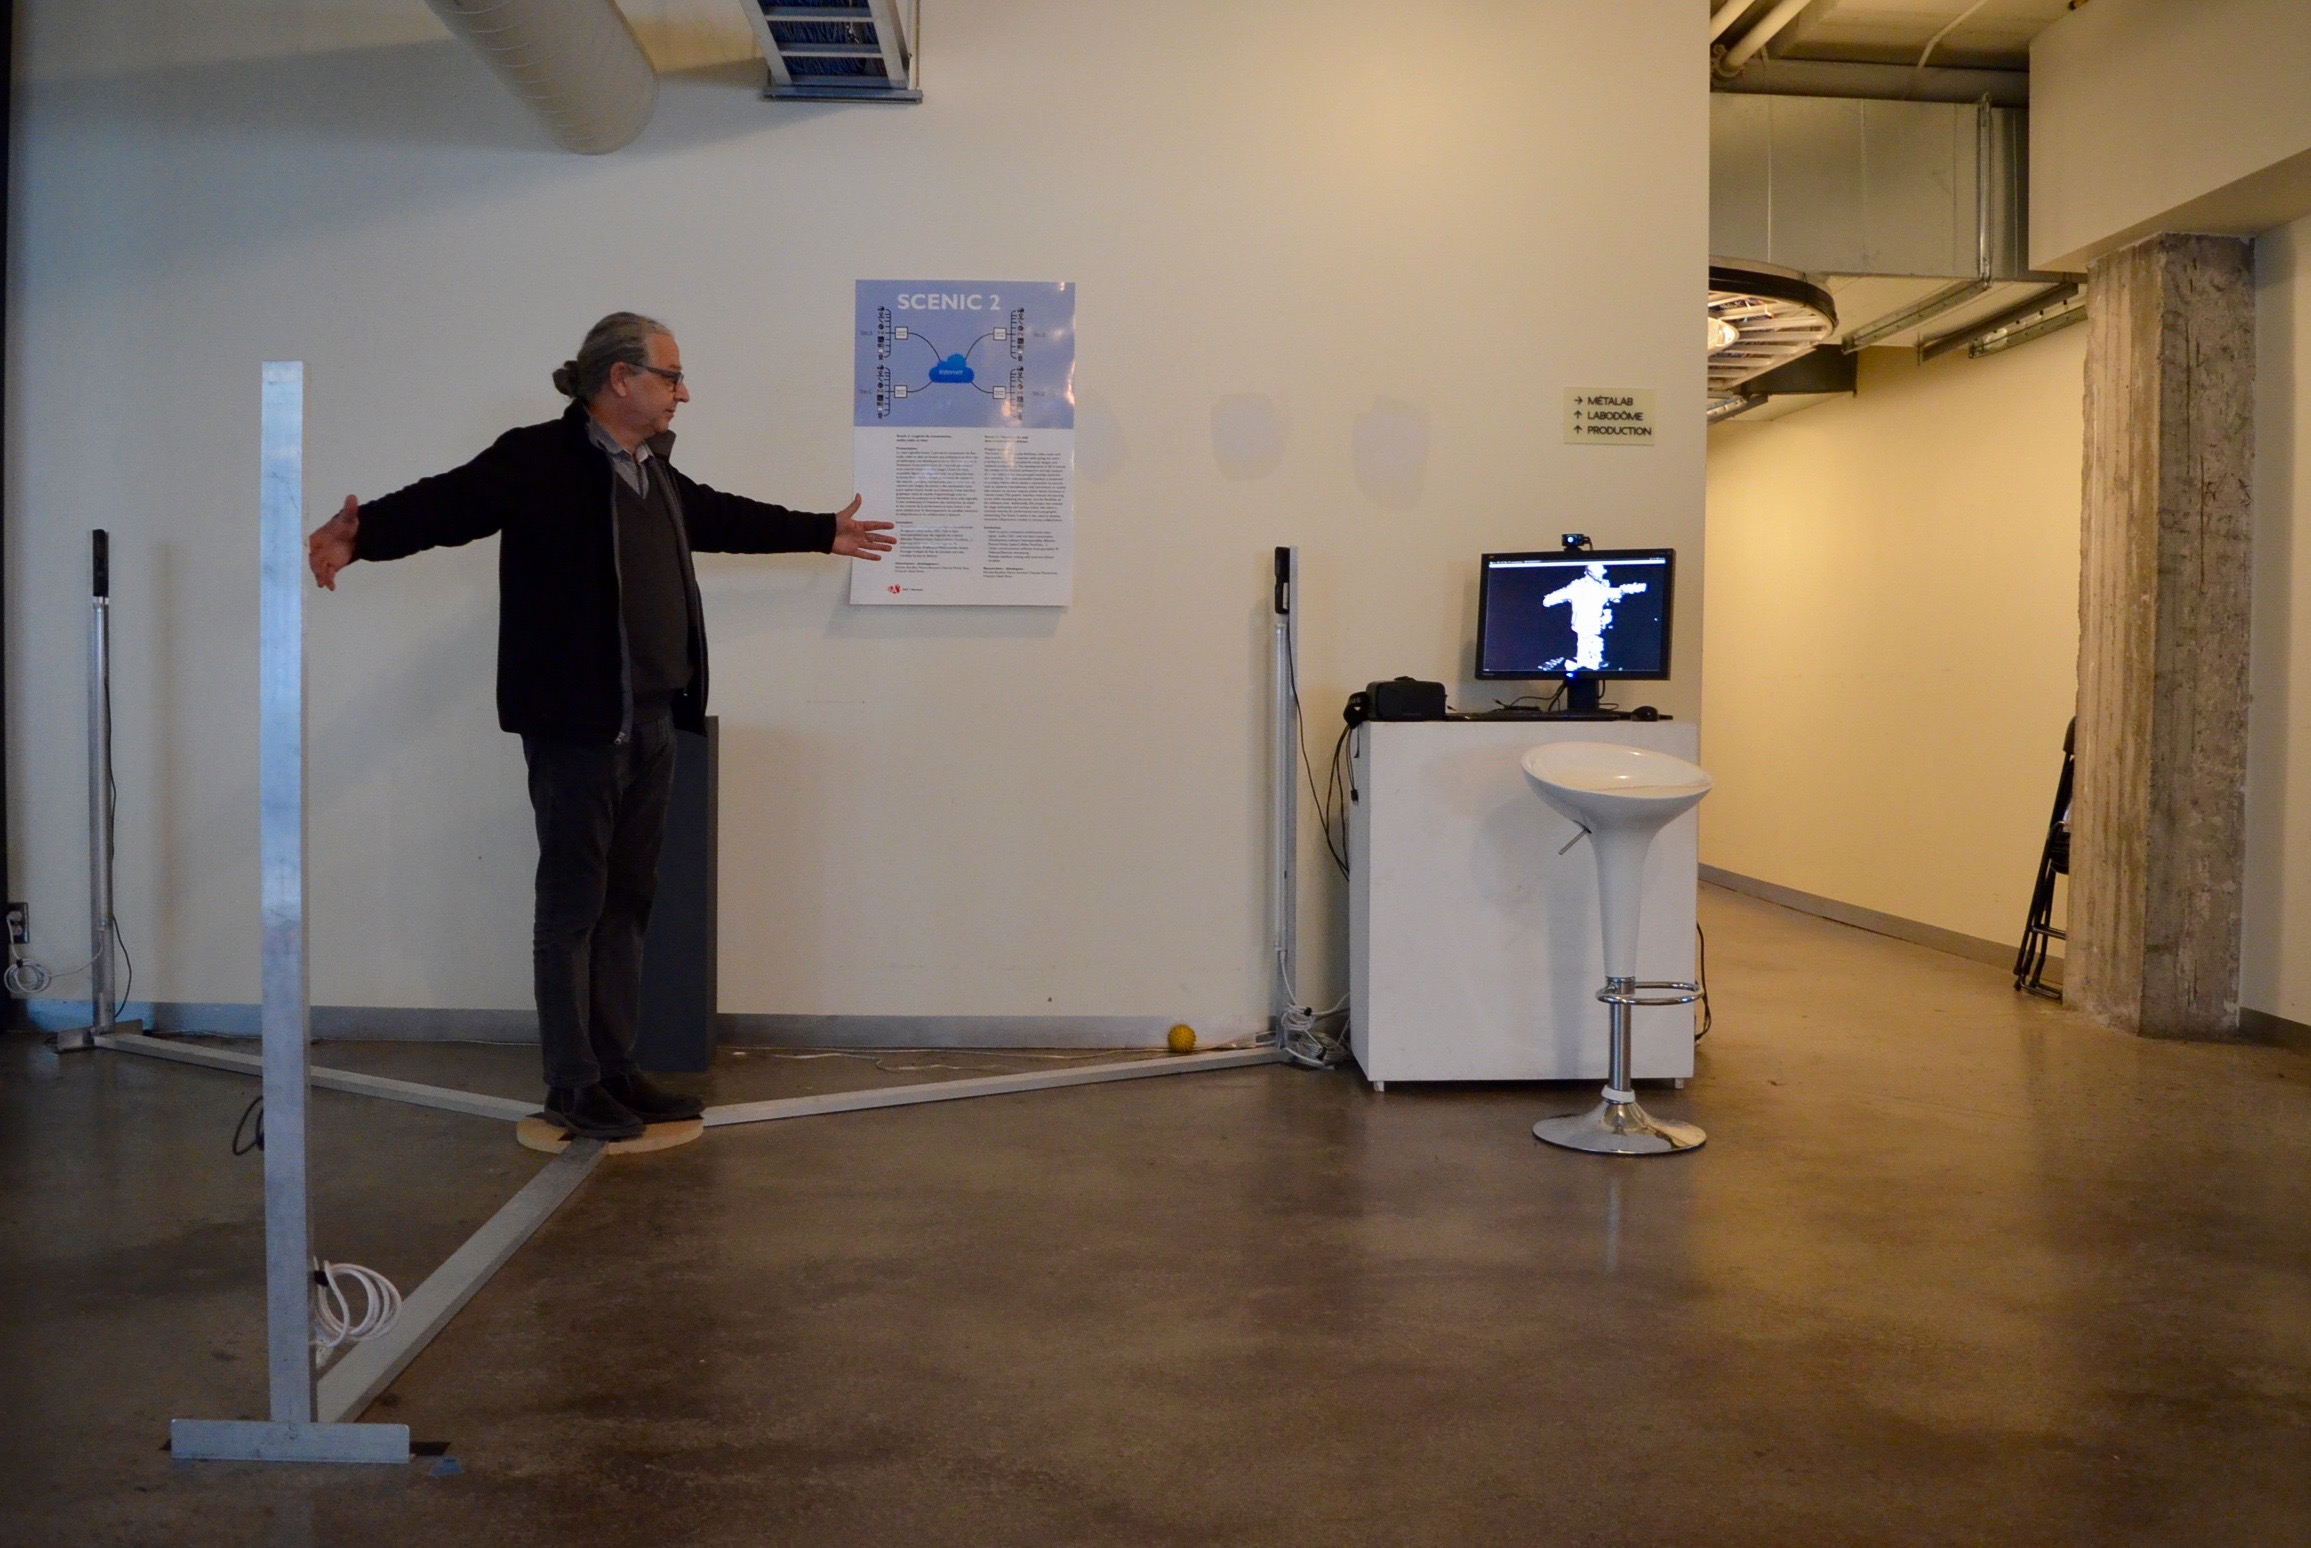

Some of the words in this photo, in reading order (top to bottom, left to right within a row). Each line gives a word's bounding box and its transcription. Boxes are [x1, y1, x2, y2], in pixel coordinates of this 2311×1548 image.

[897, 293, 982, 310] SCENIC
[989, 294, 1001, 310] 2
[1587, 395, 1634, 406] MÉTALAB
[1587, 410, 1644, 421] LABODÔME
[1587, 425, 1652, 435] PRODUCTION
